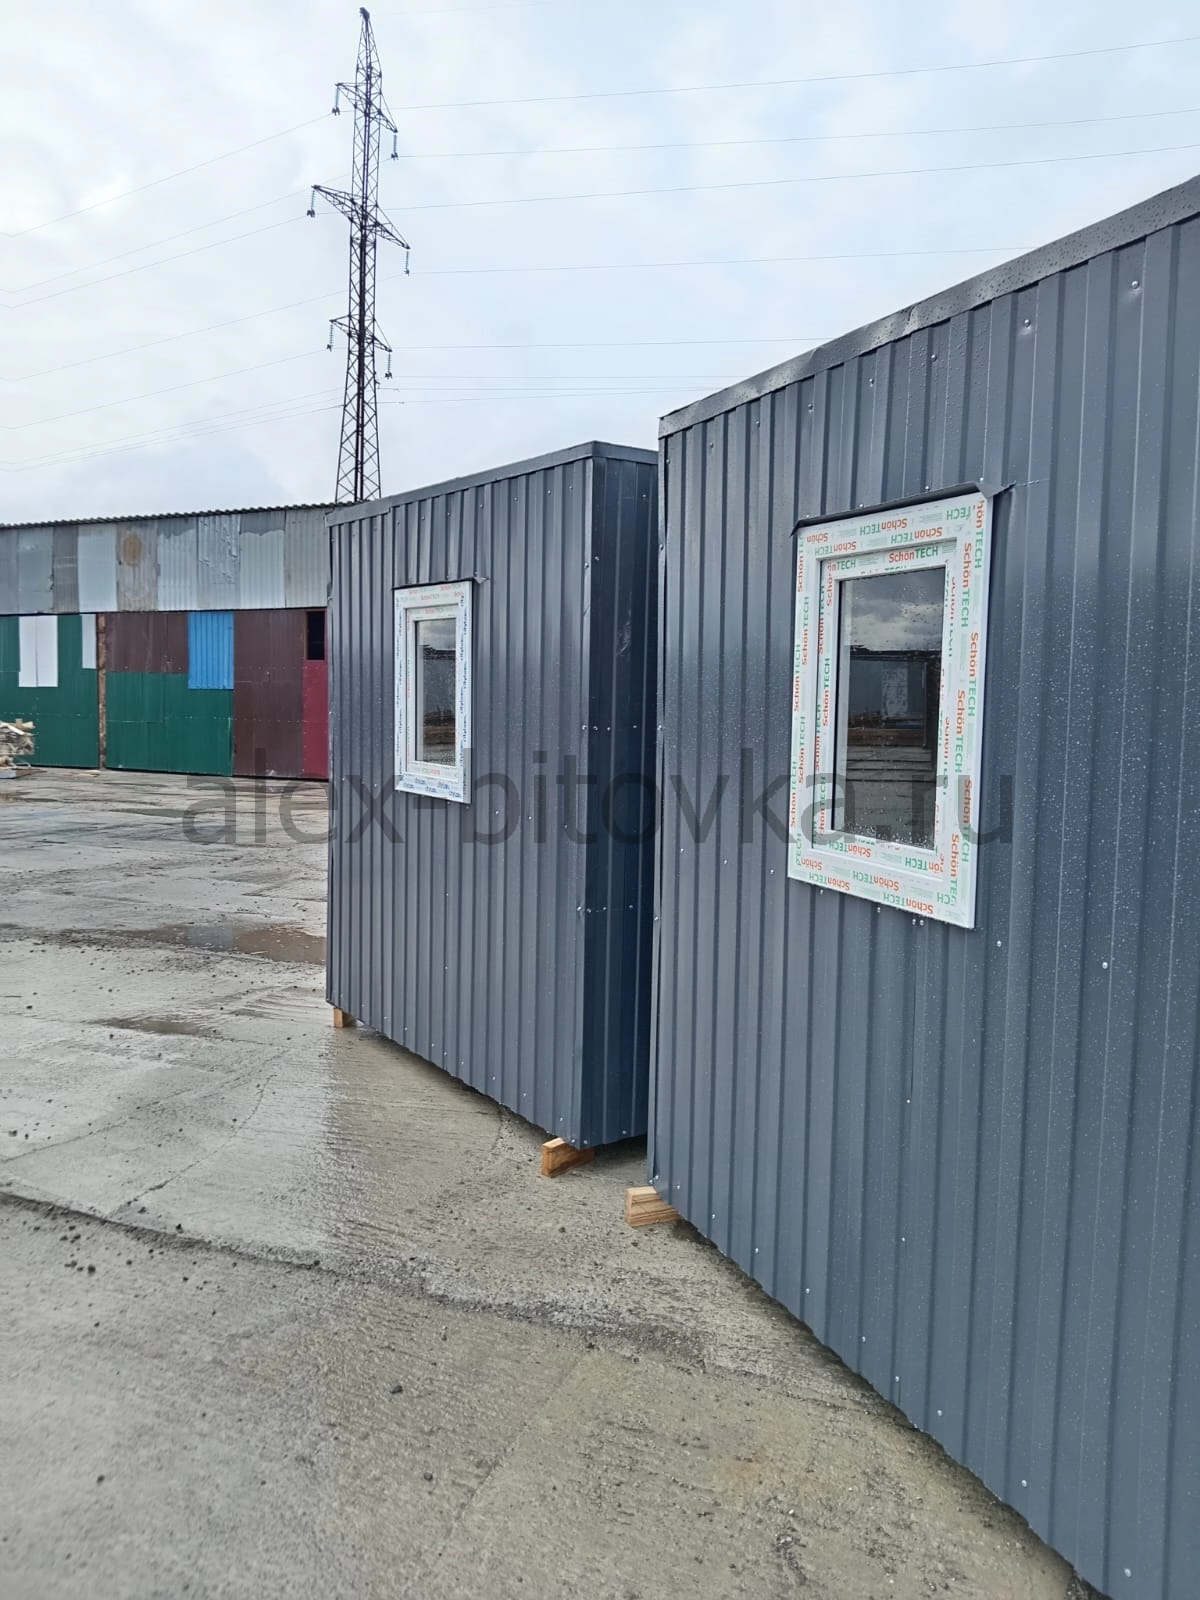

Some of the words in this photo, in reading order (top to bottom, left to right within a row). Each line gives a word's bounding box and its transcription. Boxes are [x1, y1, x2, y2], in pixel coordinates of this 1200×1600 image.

[888, 546, 939, 563] SchönTECH
[960, 543, 972, 628] SchönTECH
[967, 631, 979, 717] SchönTECH
[954, 689, 966, 774] SchönTECH
